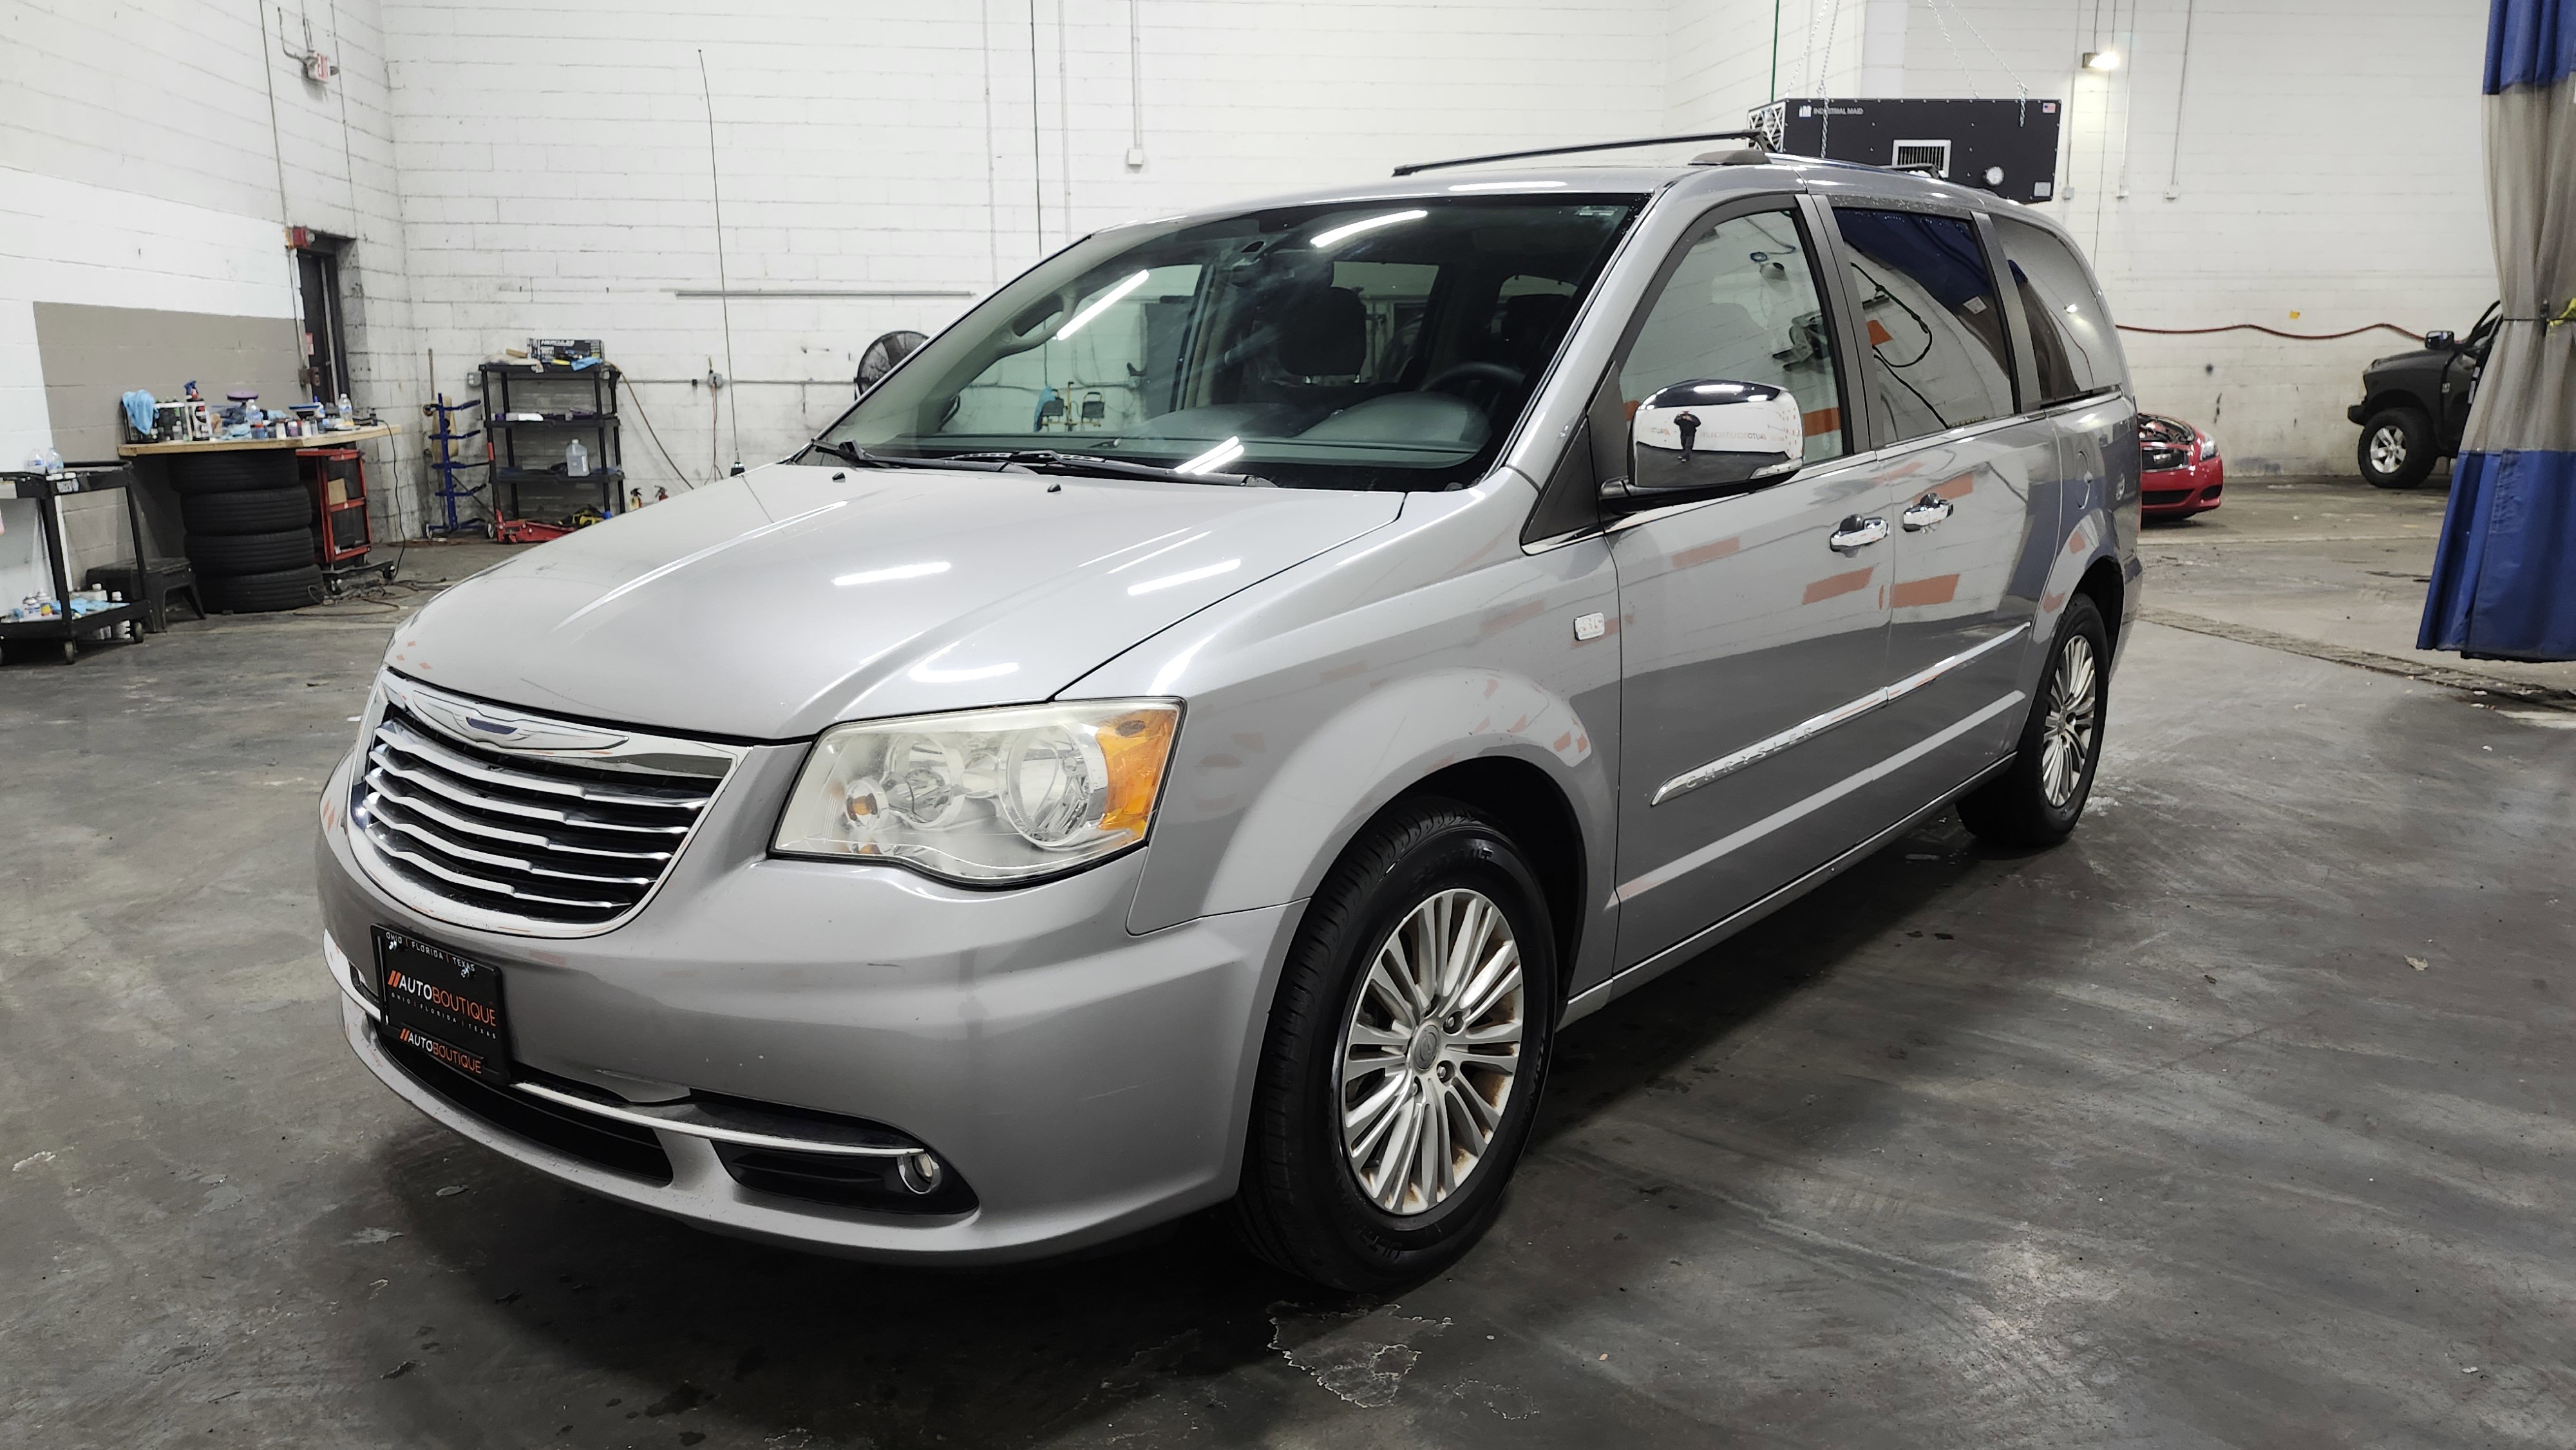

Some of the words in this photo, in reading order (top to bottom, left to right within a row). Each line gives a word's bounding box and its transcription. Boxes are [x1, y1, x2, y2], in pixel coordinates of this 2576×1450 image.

[1686, 727, 1812, 788] CHRYSLER
[386, 932, 402, 944] OHIO
[412, 941, 444, 960] FLORIDA
[452, 957, 475, 972] TEXAS
[391, 992, 411, 1004] OHIO
[420, 1003, 457, 1022] FLORIDA
[468, 1024, 497, 1039] TEXAS
[398, 974, 497, 1026] AUTOBOUTIQUE
[407, 1032, 482, 1074] AUTOBOUTIQUE
